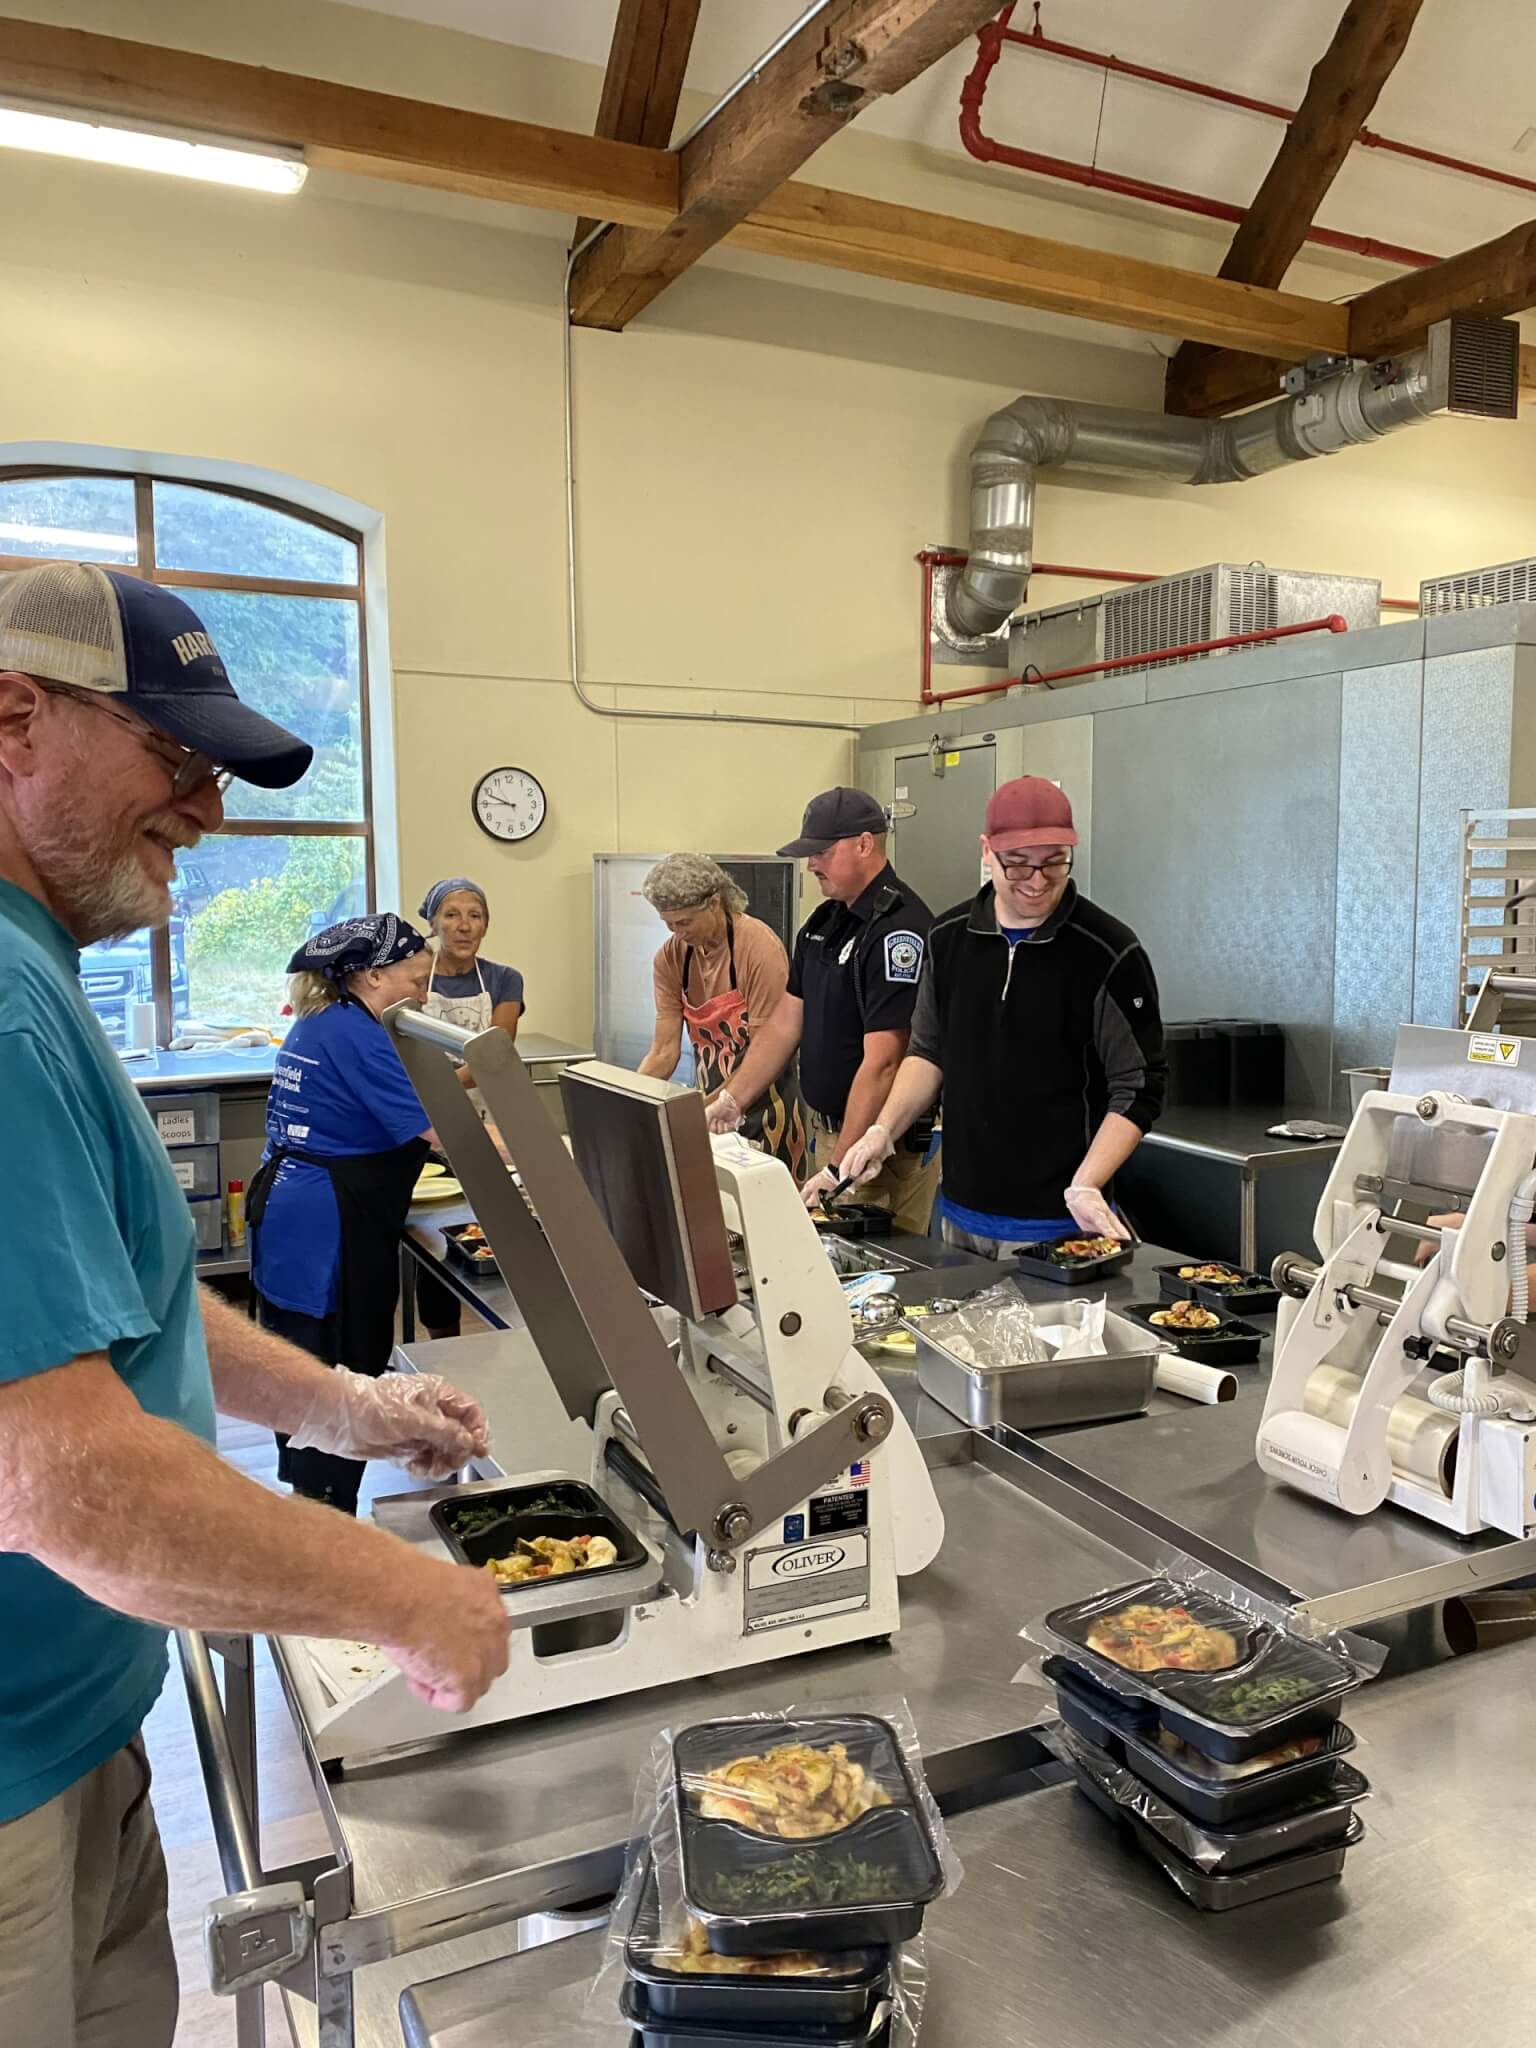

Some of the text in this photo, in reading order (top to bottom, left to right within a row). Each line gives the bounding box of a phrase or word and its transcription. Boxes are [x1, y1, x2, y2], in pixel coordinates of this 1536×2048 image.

[495, 778, 501, 787] 11
[505, 775, 514, 784] 12
[520, 779, 524, 787] 1
[527, 788, 533, 797] 2
[482, 800, 488, 808] 9
[531, 800, 537, 809] 3
[486, 812, 492, 821] 8
[529, 813, 534, 821] 4
[496, 822, 501, 831] 7
[508, 825, 514, 833] 6
[520, 822, 526, 831] 5
[163, 1115, 189, 1125] Ladies
[161, 1130, 191, 1139] Scoops
[823, 1493, 855, 1504] PATENTED
[782, 1551, 836, 1572] OLIVER
